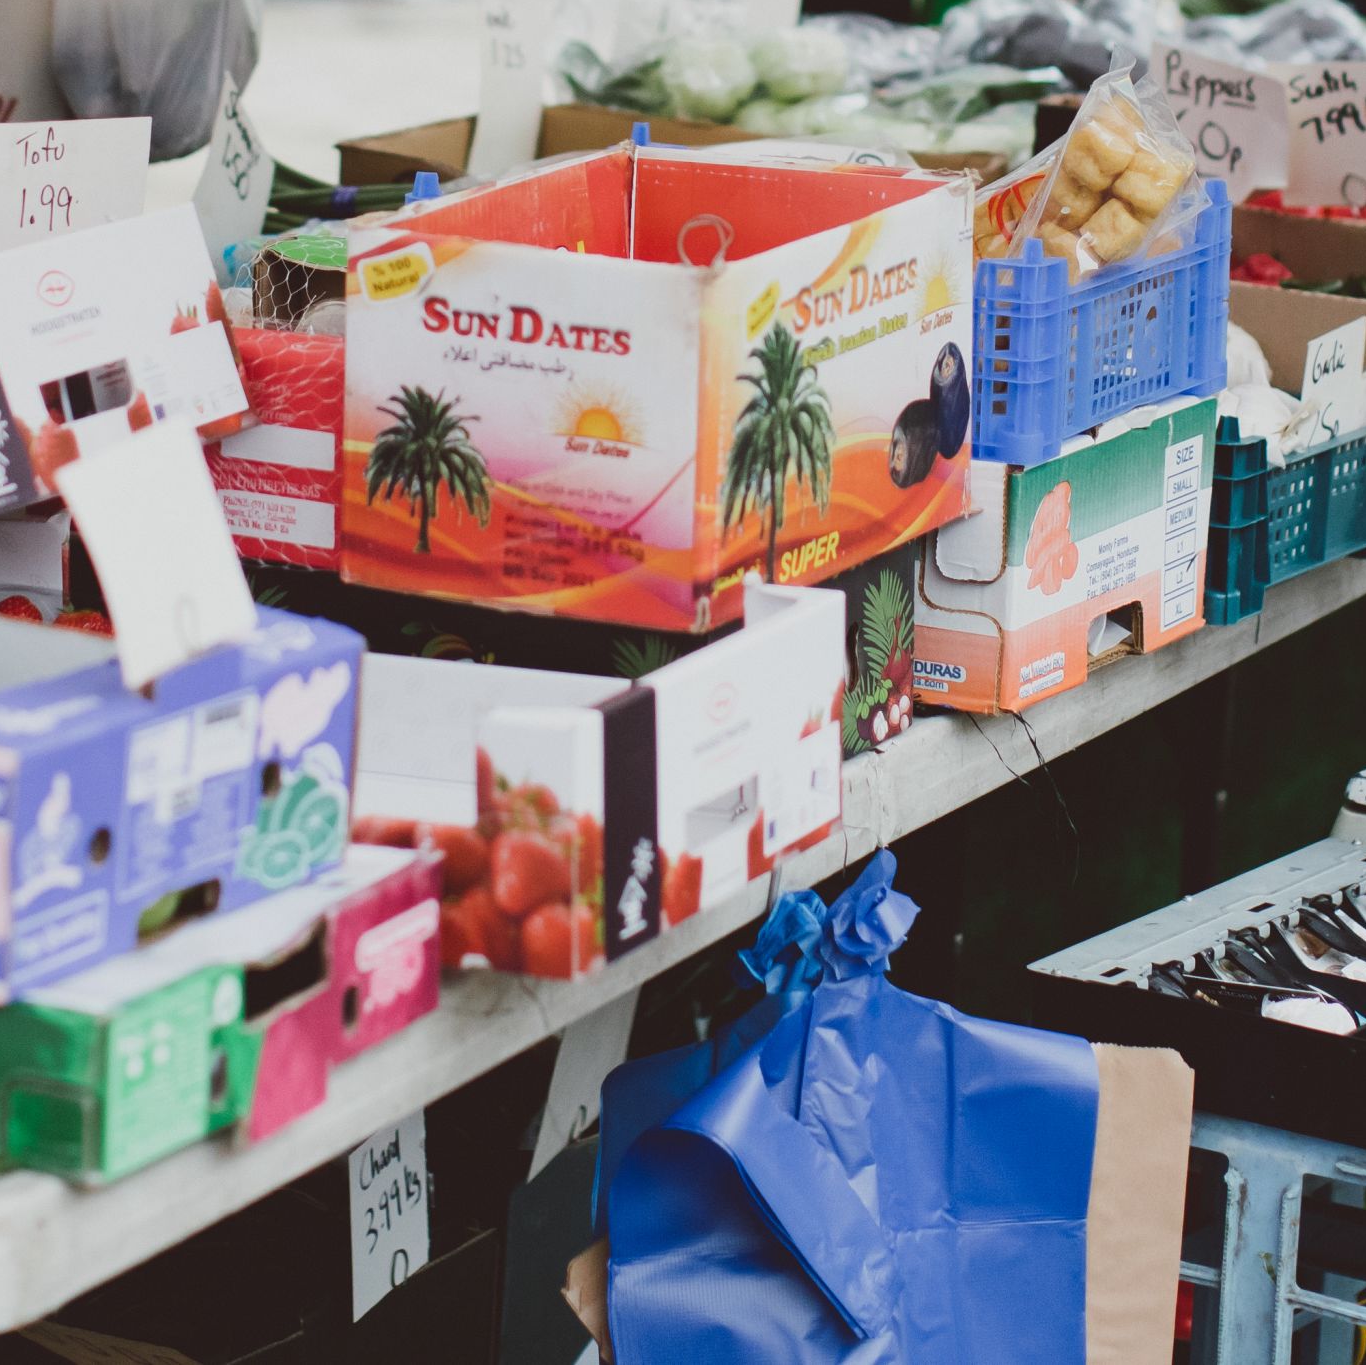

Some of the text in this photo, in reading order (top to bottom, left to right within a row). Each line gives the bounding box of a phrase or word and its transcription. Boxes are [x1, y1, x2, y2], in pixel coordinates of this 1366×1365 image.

[16, 126, 65, 166] Tofu
[1175, 445, 1194, 465] SIZE
[1172, 476, 1194, 495] SMALL
[1169, 505, 1195, 525] MEDIUM
[1114, 536, 1129, 548] Farms
[778, 530, 840, 583] SUPER
[1175, 601, 1184, 615] XL
[914, 660, 962, 680] DURAS
